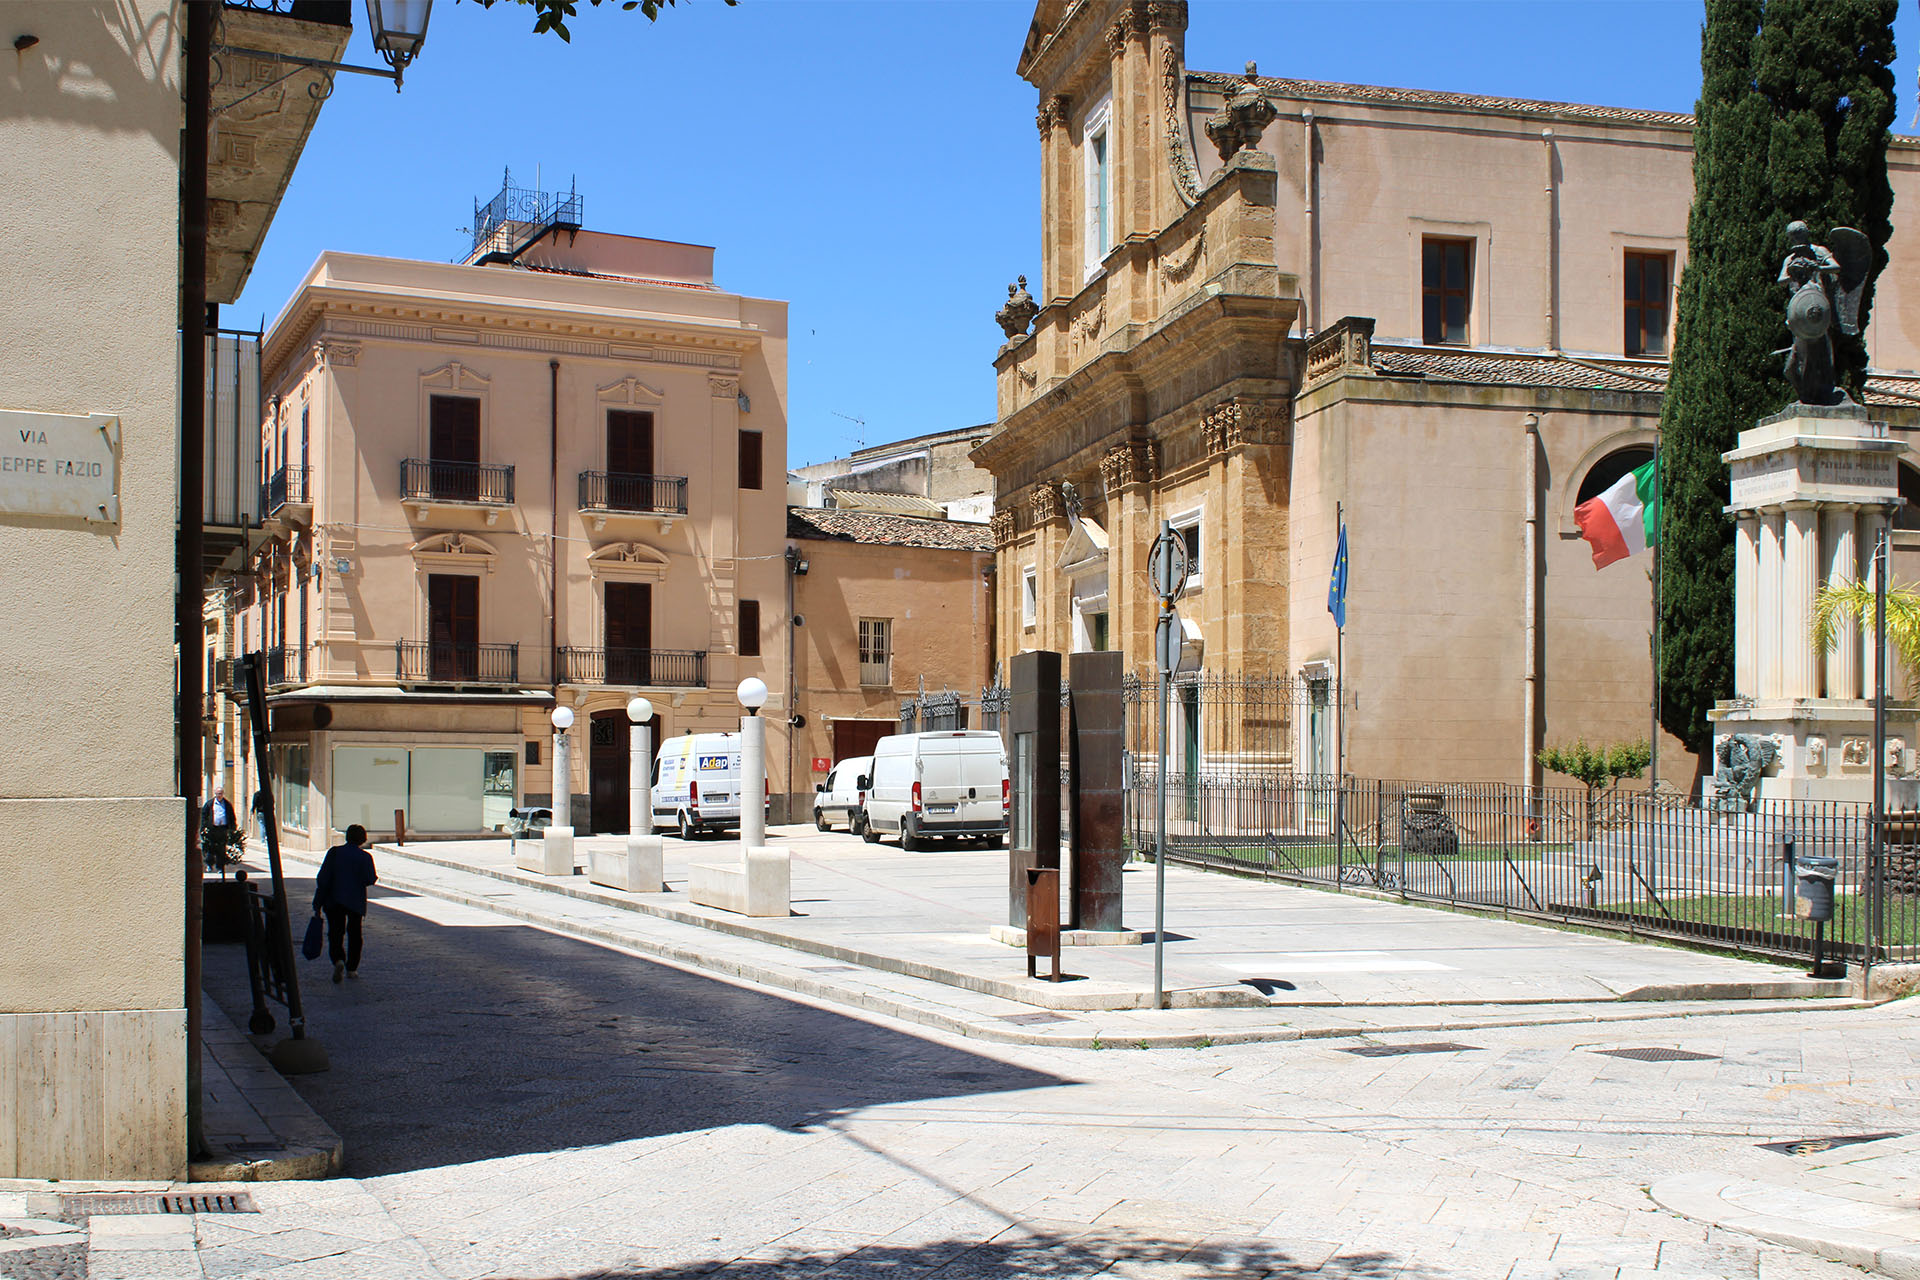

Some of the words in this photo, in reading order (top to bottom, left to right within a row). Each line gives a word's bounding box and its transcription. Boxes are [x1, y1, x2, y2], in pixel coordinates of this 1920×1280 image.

[20, 430, 48, 444] VIA
[0, 456, 47, 474] EPPE
[55, 460, 102, 477] FAZIO
[702, 757, 728, 768] Adap
